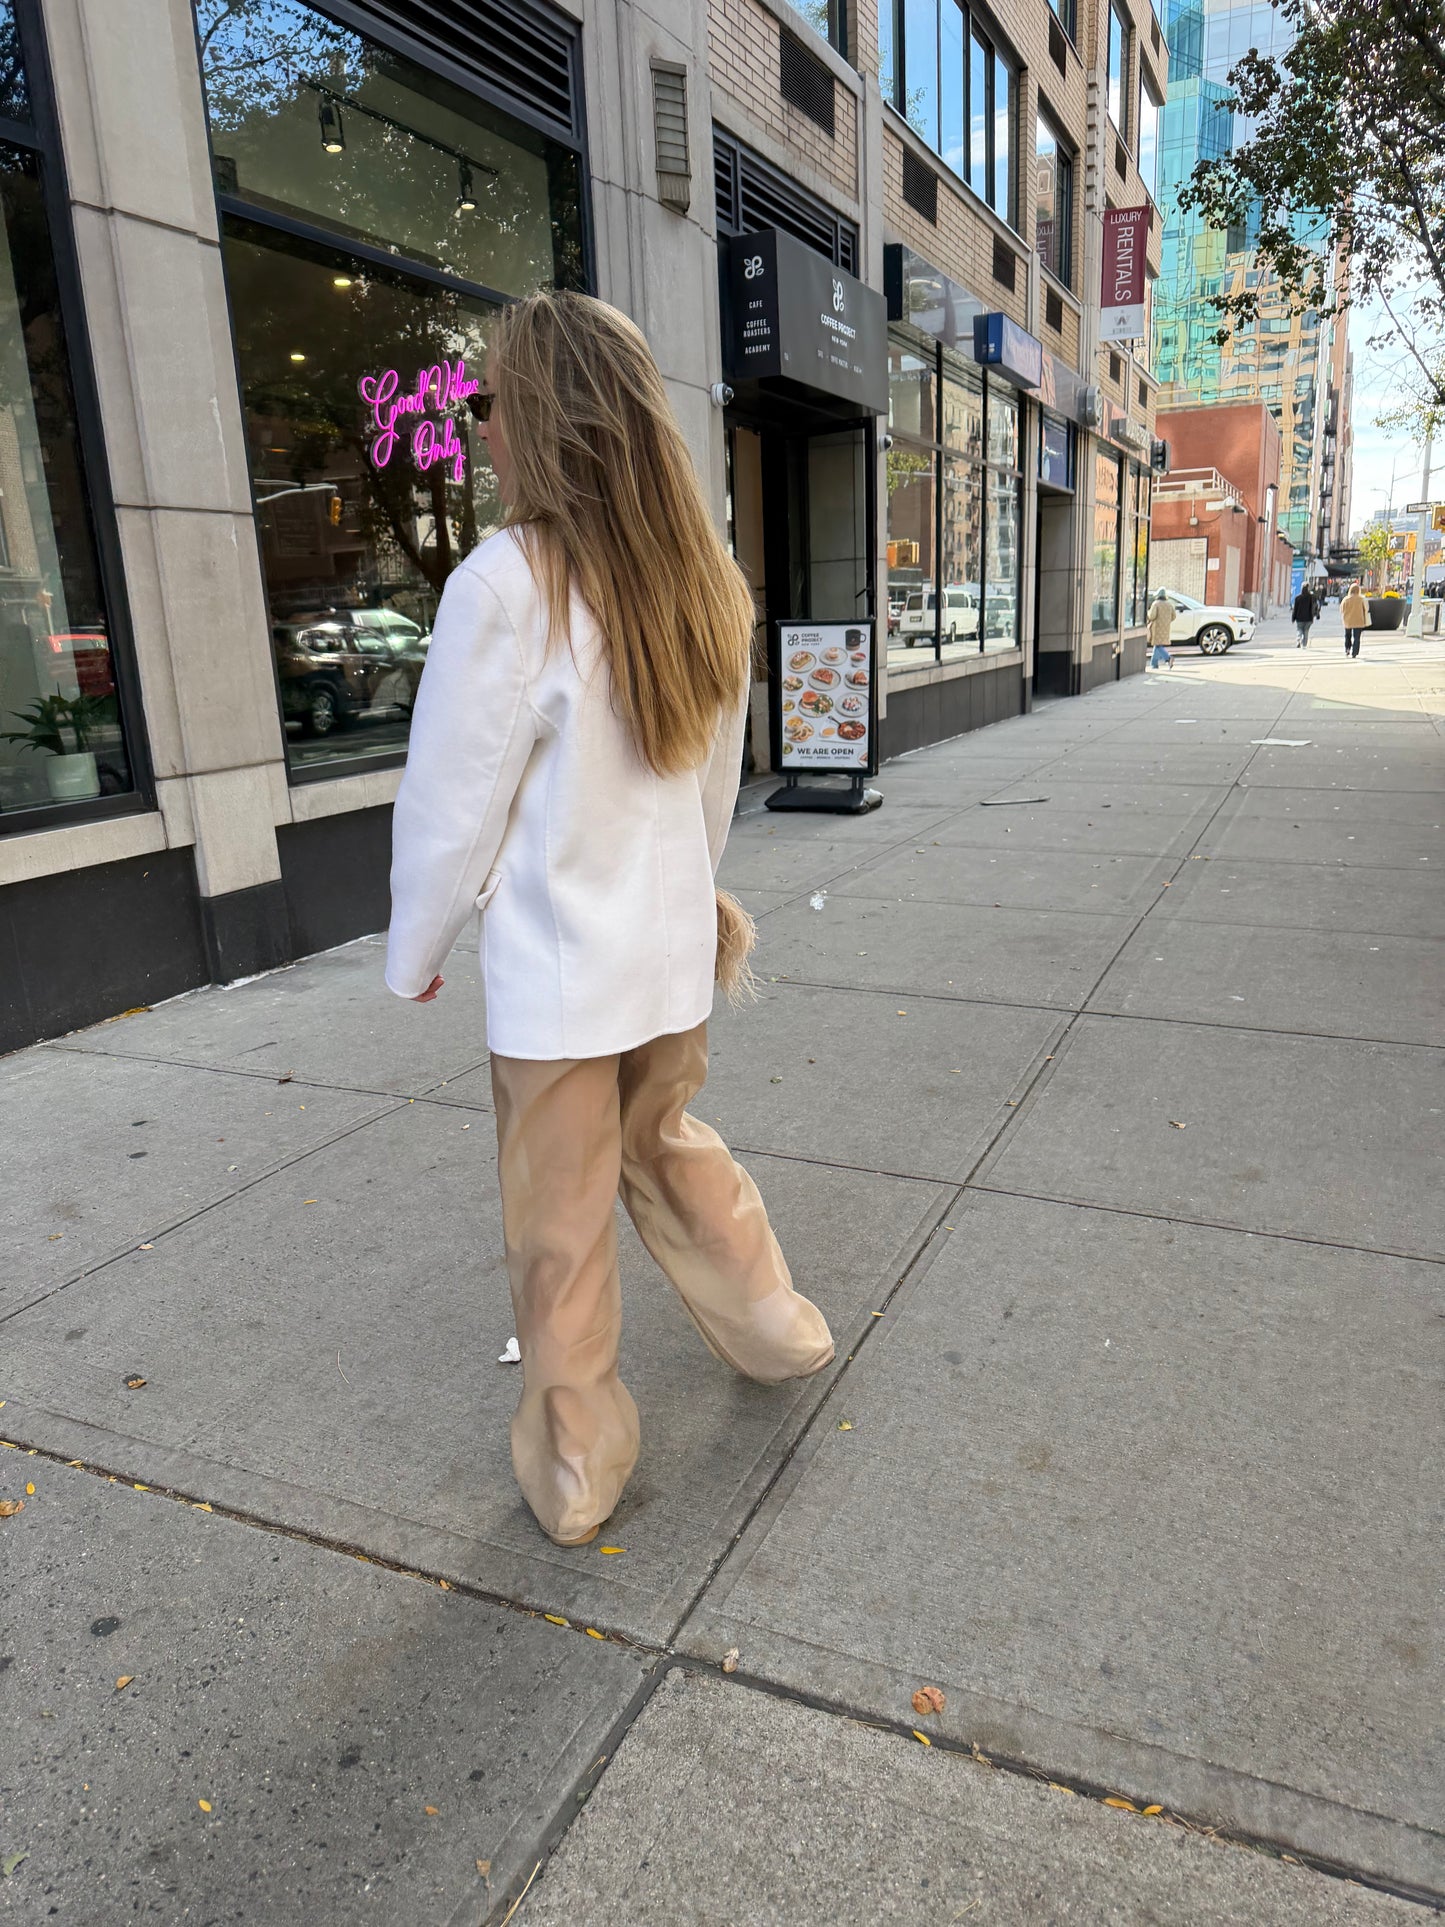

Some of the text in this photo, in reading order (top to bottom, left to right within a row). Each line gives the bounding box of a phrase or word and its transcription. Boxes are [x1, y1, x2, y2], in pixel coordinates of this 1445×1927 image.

[1110, 211, 1142, 225] LUXURY
[1114, 226, 1135, 302] RENTALS
[749, 300, 762, 309] CAFE
[746, 319, 766, 328] COFFEE
[821, 314, 837, 330] COFFEE
[743, 327, 770, 337] ROASTERS
[745, 344, 770, 354] ACADEMY
[361, 360, 479, 468] Good Vibes
[413, 418, 467, 482] Only
[797, 747, 854, 756] WE ARE OPEN
